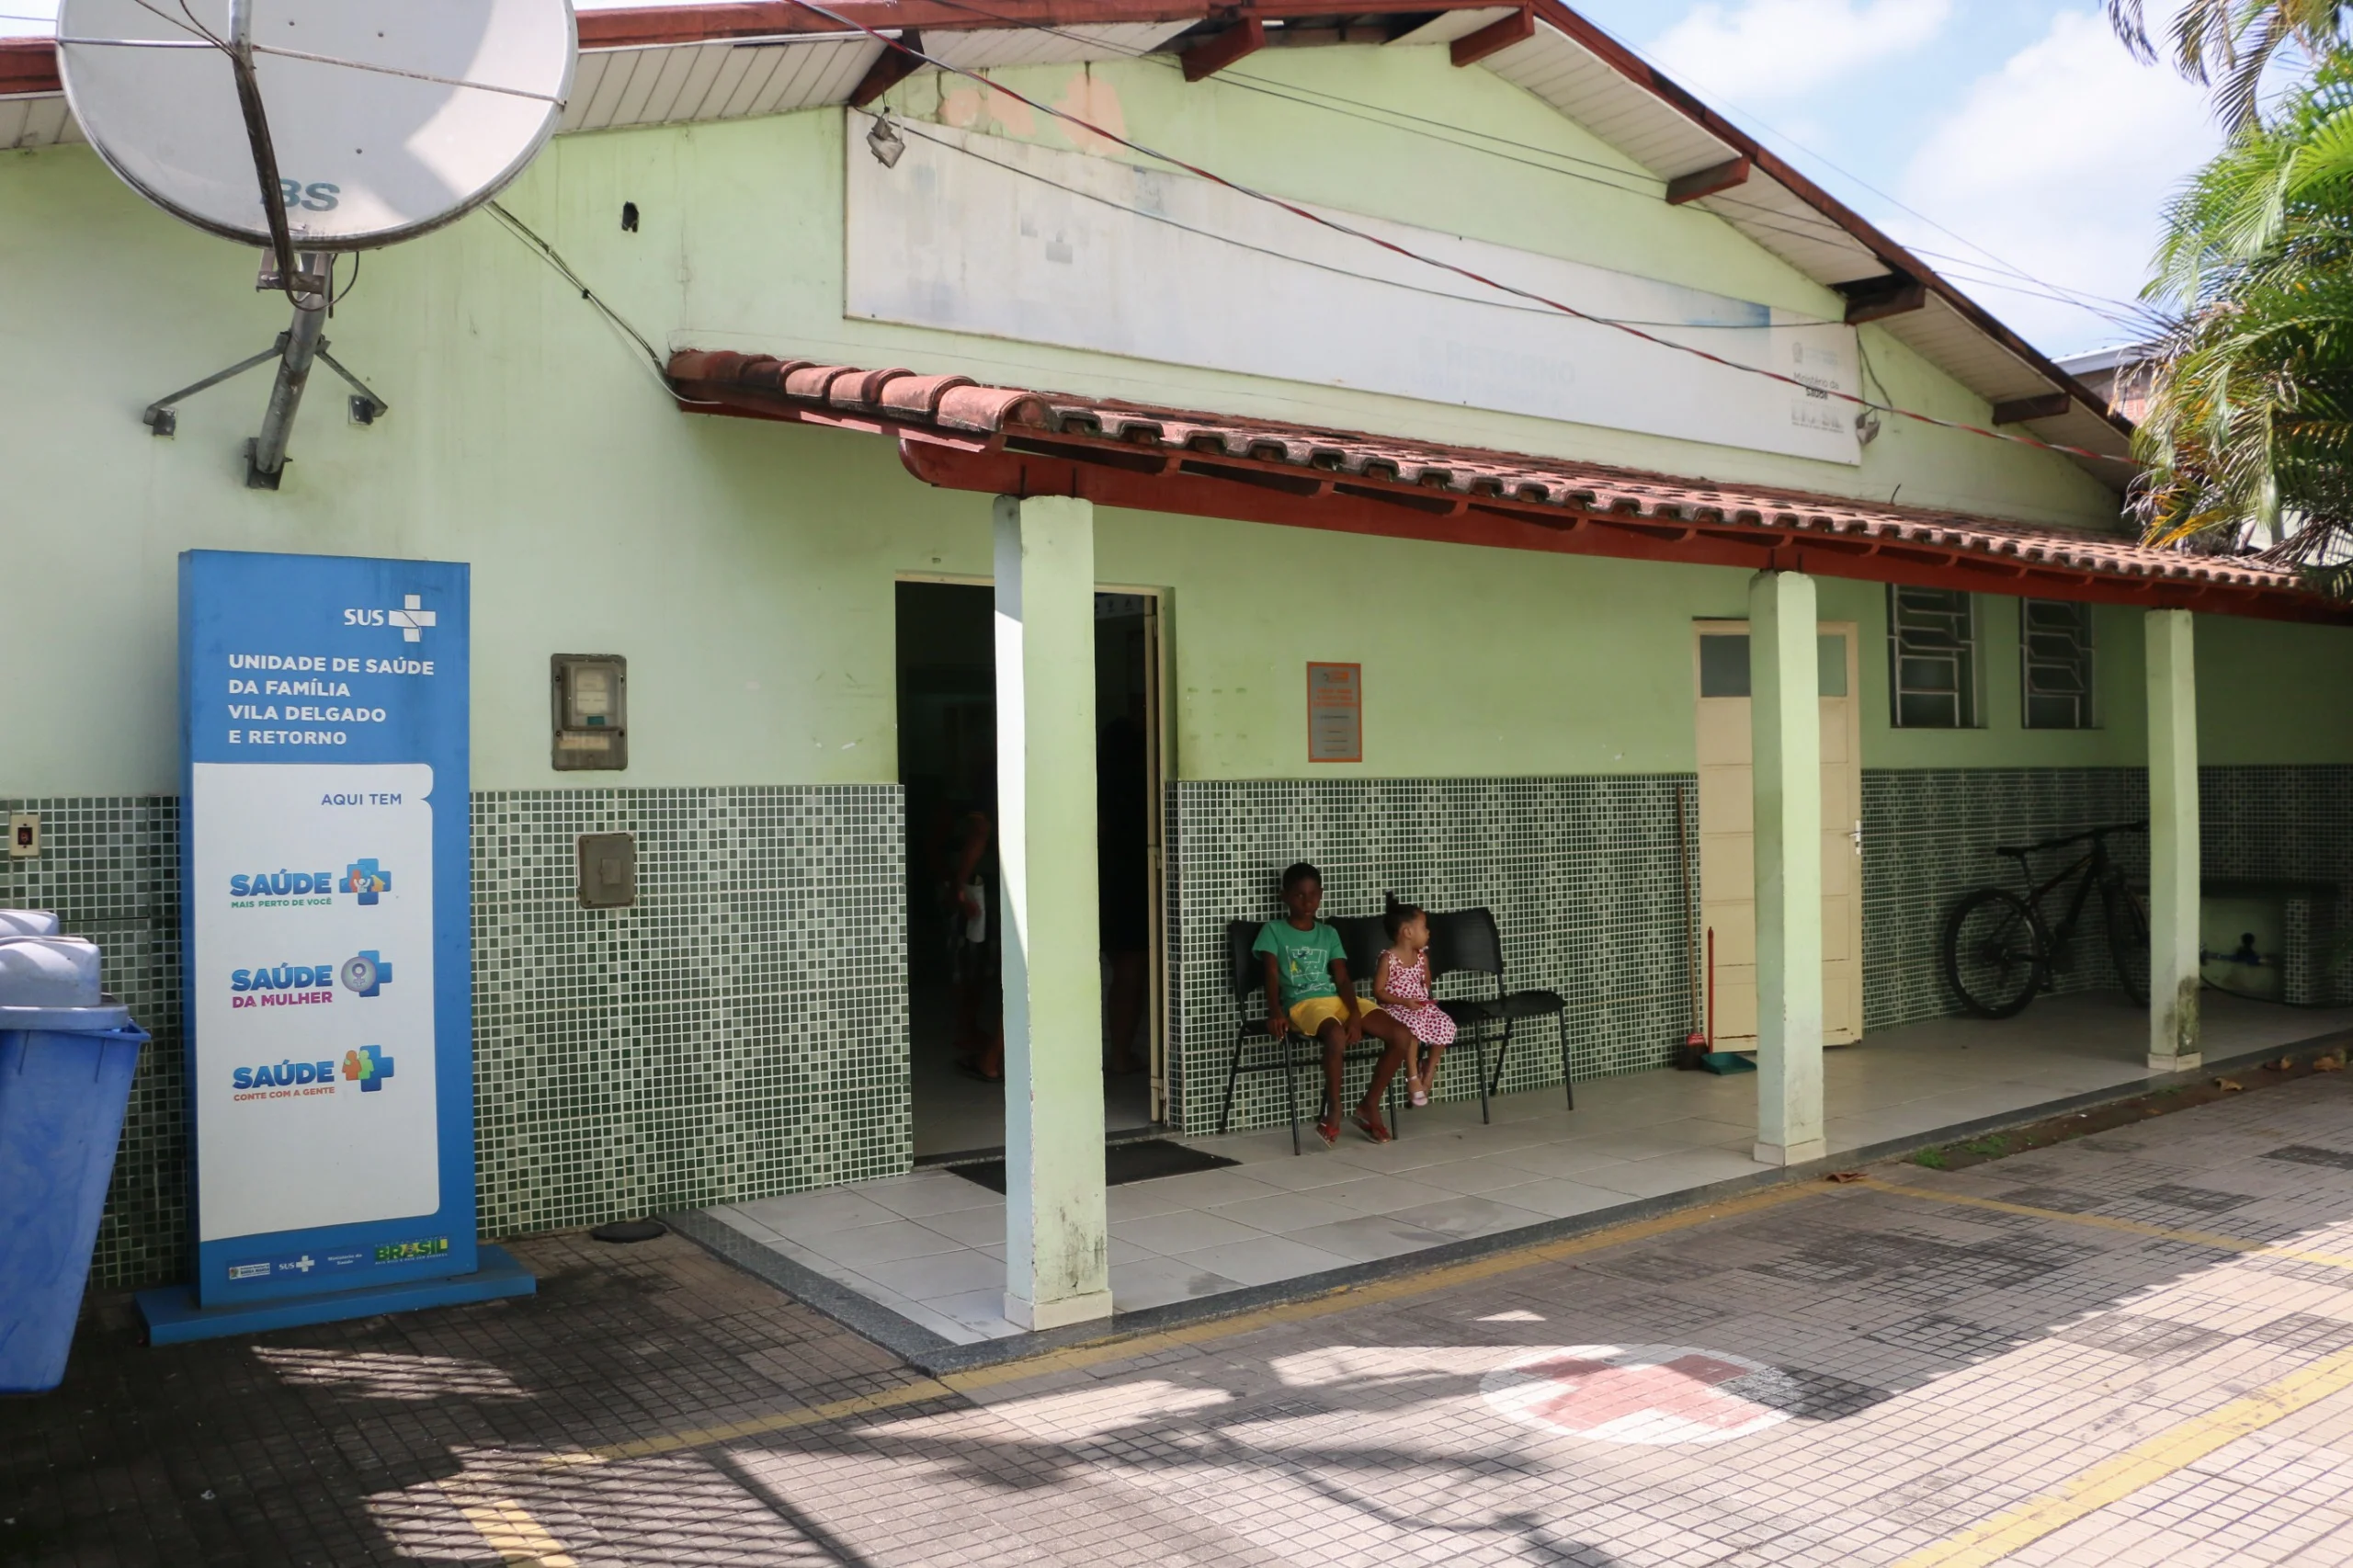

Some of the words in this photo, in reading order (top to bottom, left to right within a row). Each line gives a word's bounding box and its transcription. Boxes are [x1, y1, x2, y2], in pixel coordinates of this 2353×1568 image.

[260, 178, 340, 211] BS
[344, 608, 384, 626] SUS
[229, 653, 326, 672] UNIDADE
[332, 658, 360, 673] DE
[365, 656, 435, 676] SAÚDE
[229, 679, 259, 695] DA
[266, 678, 351, 697] FAMÍLIA
[228, 704, 278, 721] VILA
[285, 706, 387, 722] DELGADO
[229, 730, 242, 744] E
[248, 731, 347, 745] RETORNO
[321, 793, 364, 806] AQUI
[369, 793, 403, 806] TEM
[230, 869, 333, 897] SAÚDE
[307, 897, 333, 905] VOCÊ
[231, 961, 334, 992] SAÚDE
[232, 995, 257, 1008] DA
[261, 991, 333, 1006] MULHER
[233, 1059, 335, 1089] SAÚDE
[233, 1092, 267, 1101] CONTE
[269, 1090, 291, 1098] COM
[302, 1086, 335, 1096] GENTE
[375, 1238, 449, 1261] BRASIL
[278, 1262, 295, 1270] SUS
